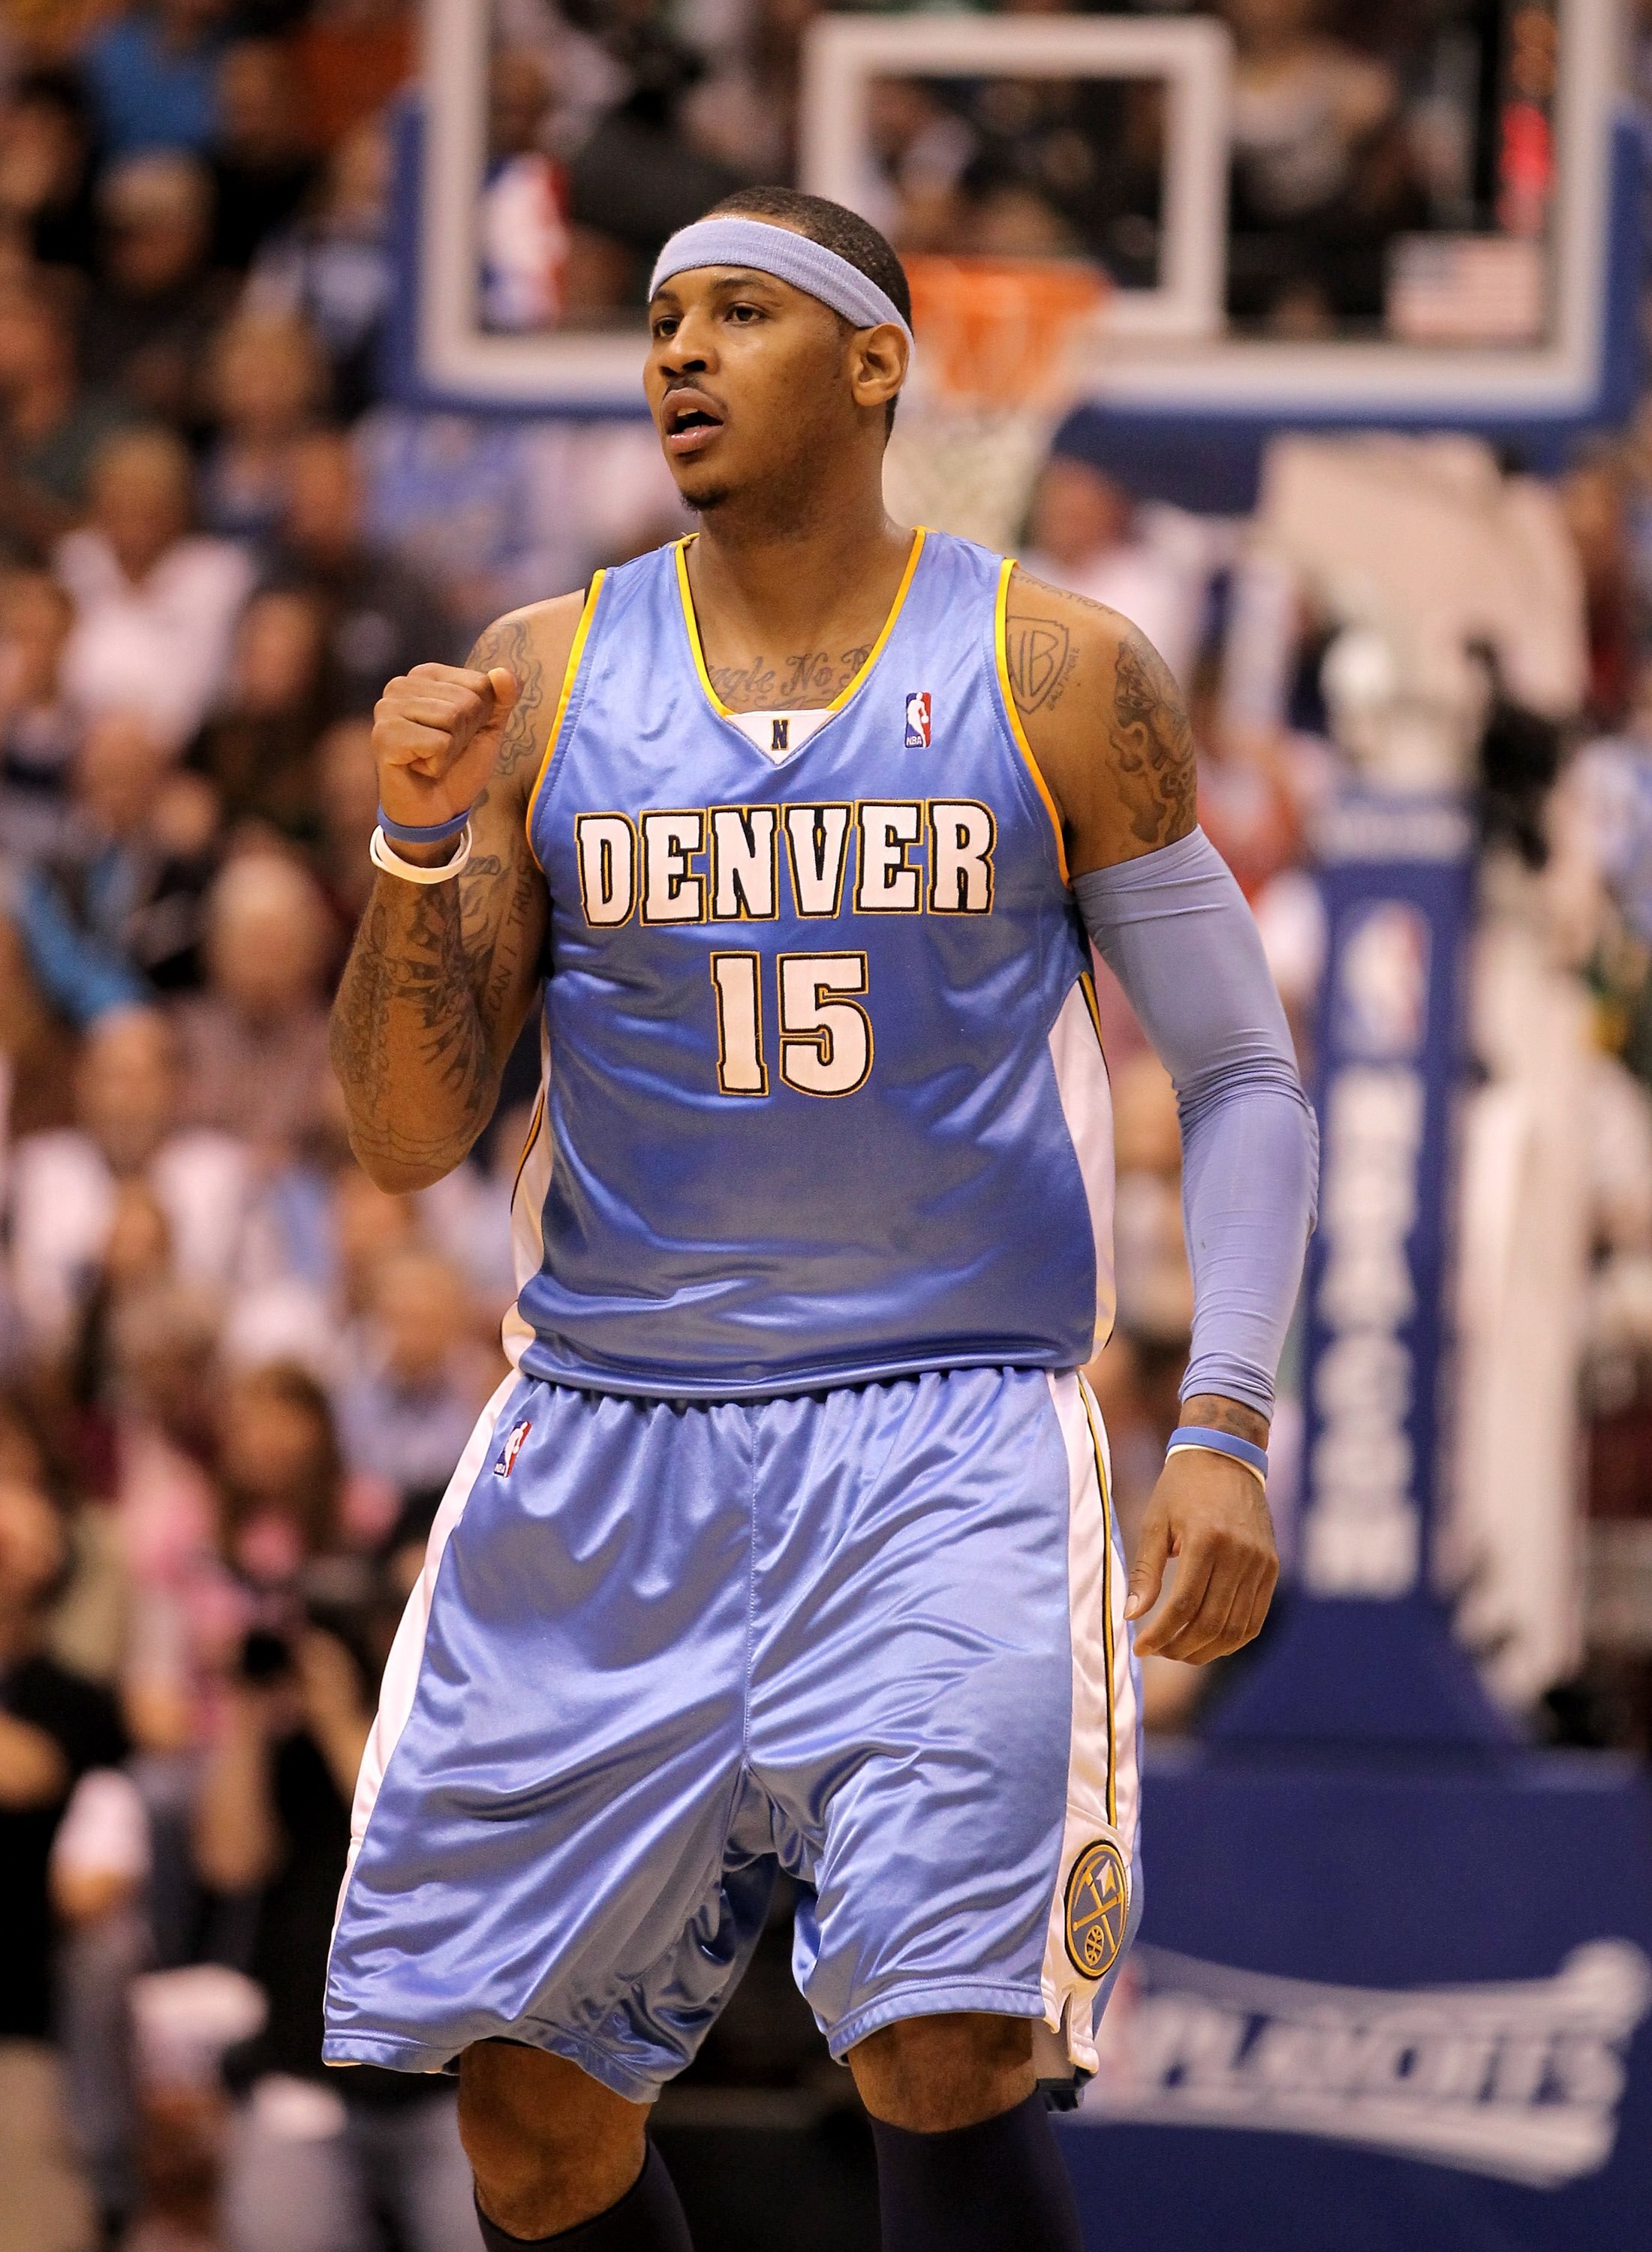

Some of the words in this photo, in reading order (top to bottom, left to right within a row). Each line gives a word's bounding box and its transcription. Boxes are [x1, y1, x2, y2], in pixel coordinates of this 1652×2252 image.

[772, 718, 789, 751] N
[906, 735, 922, 746] NBA
[575, 799, 997, 928] DENVER
[710, 950, 874, 1097] 15
